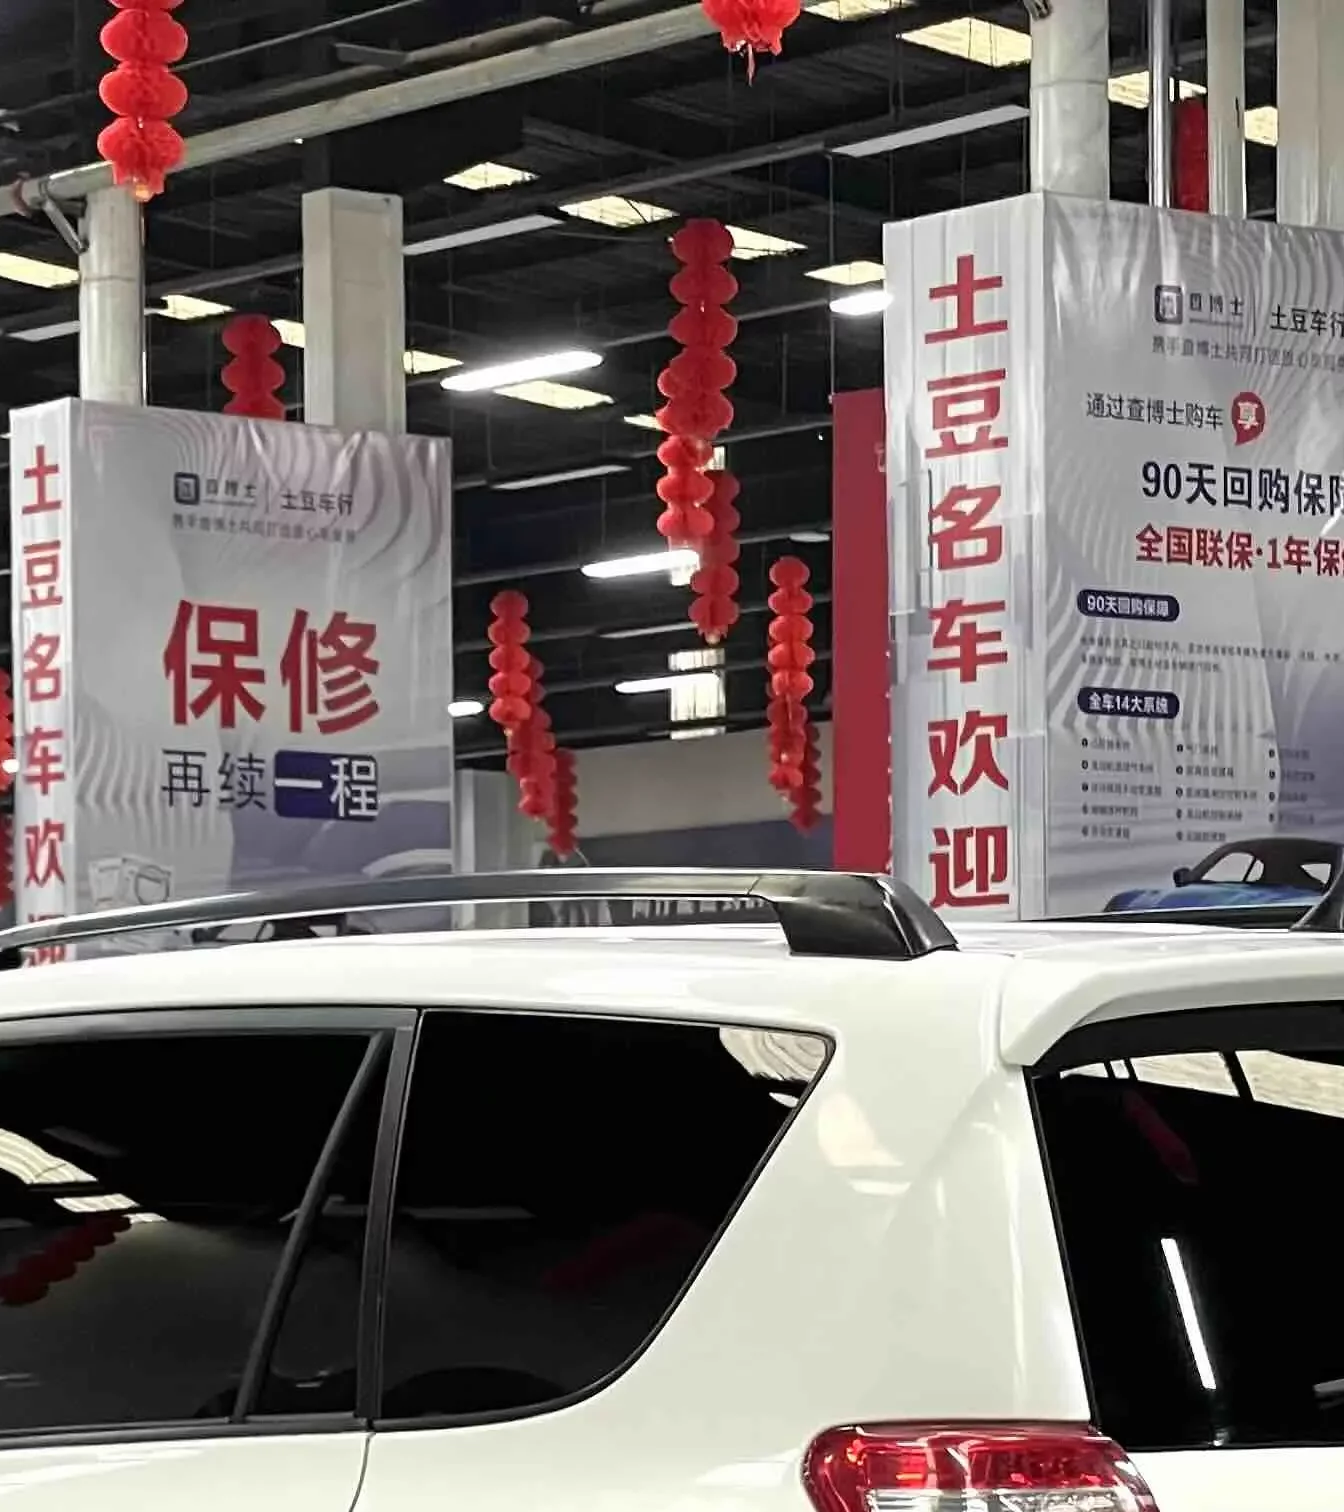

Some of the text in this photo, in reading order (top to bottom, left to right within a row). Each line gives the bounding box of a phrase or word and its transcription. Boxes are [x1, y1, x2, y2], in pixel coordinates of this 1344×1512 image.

[1086, 392, 1223, 430] 通过查博士购车
[924, 254, 1010, 908] 土豆名车欢迎
[163, 600, 380, 735] 保修
[161, 748, 378, 819] 再续一程
